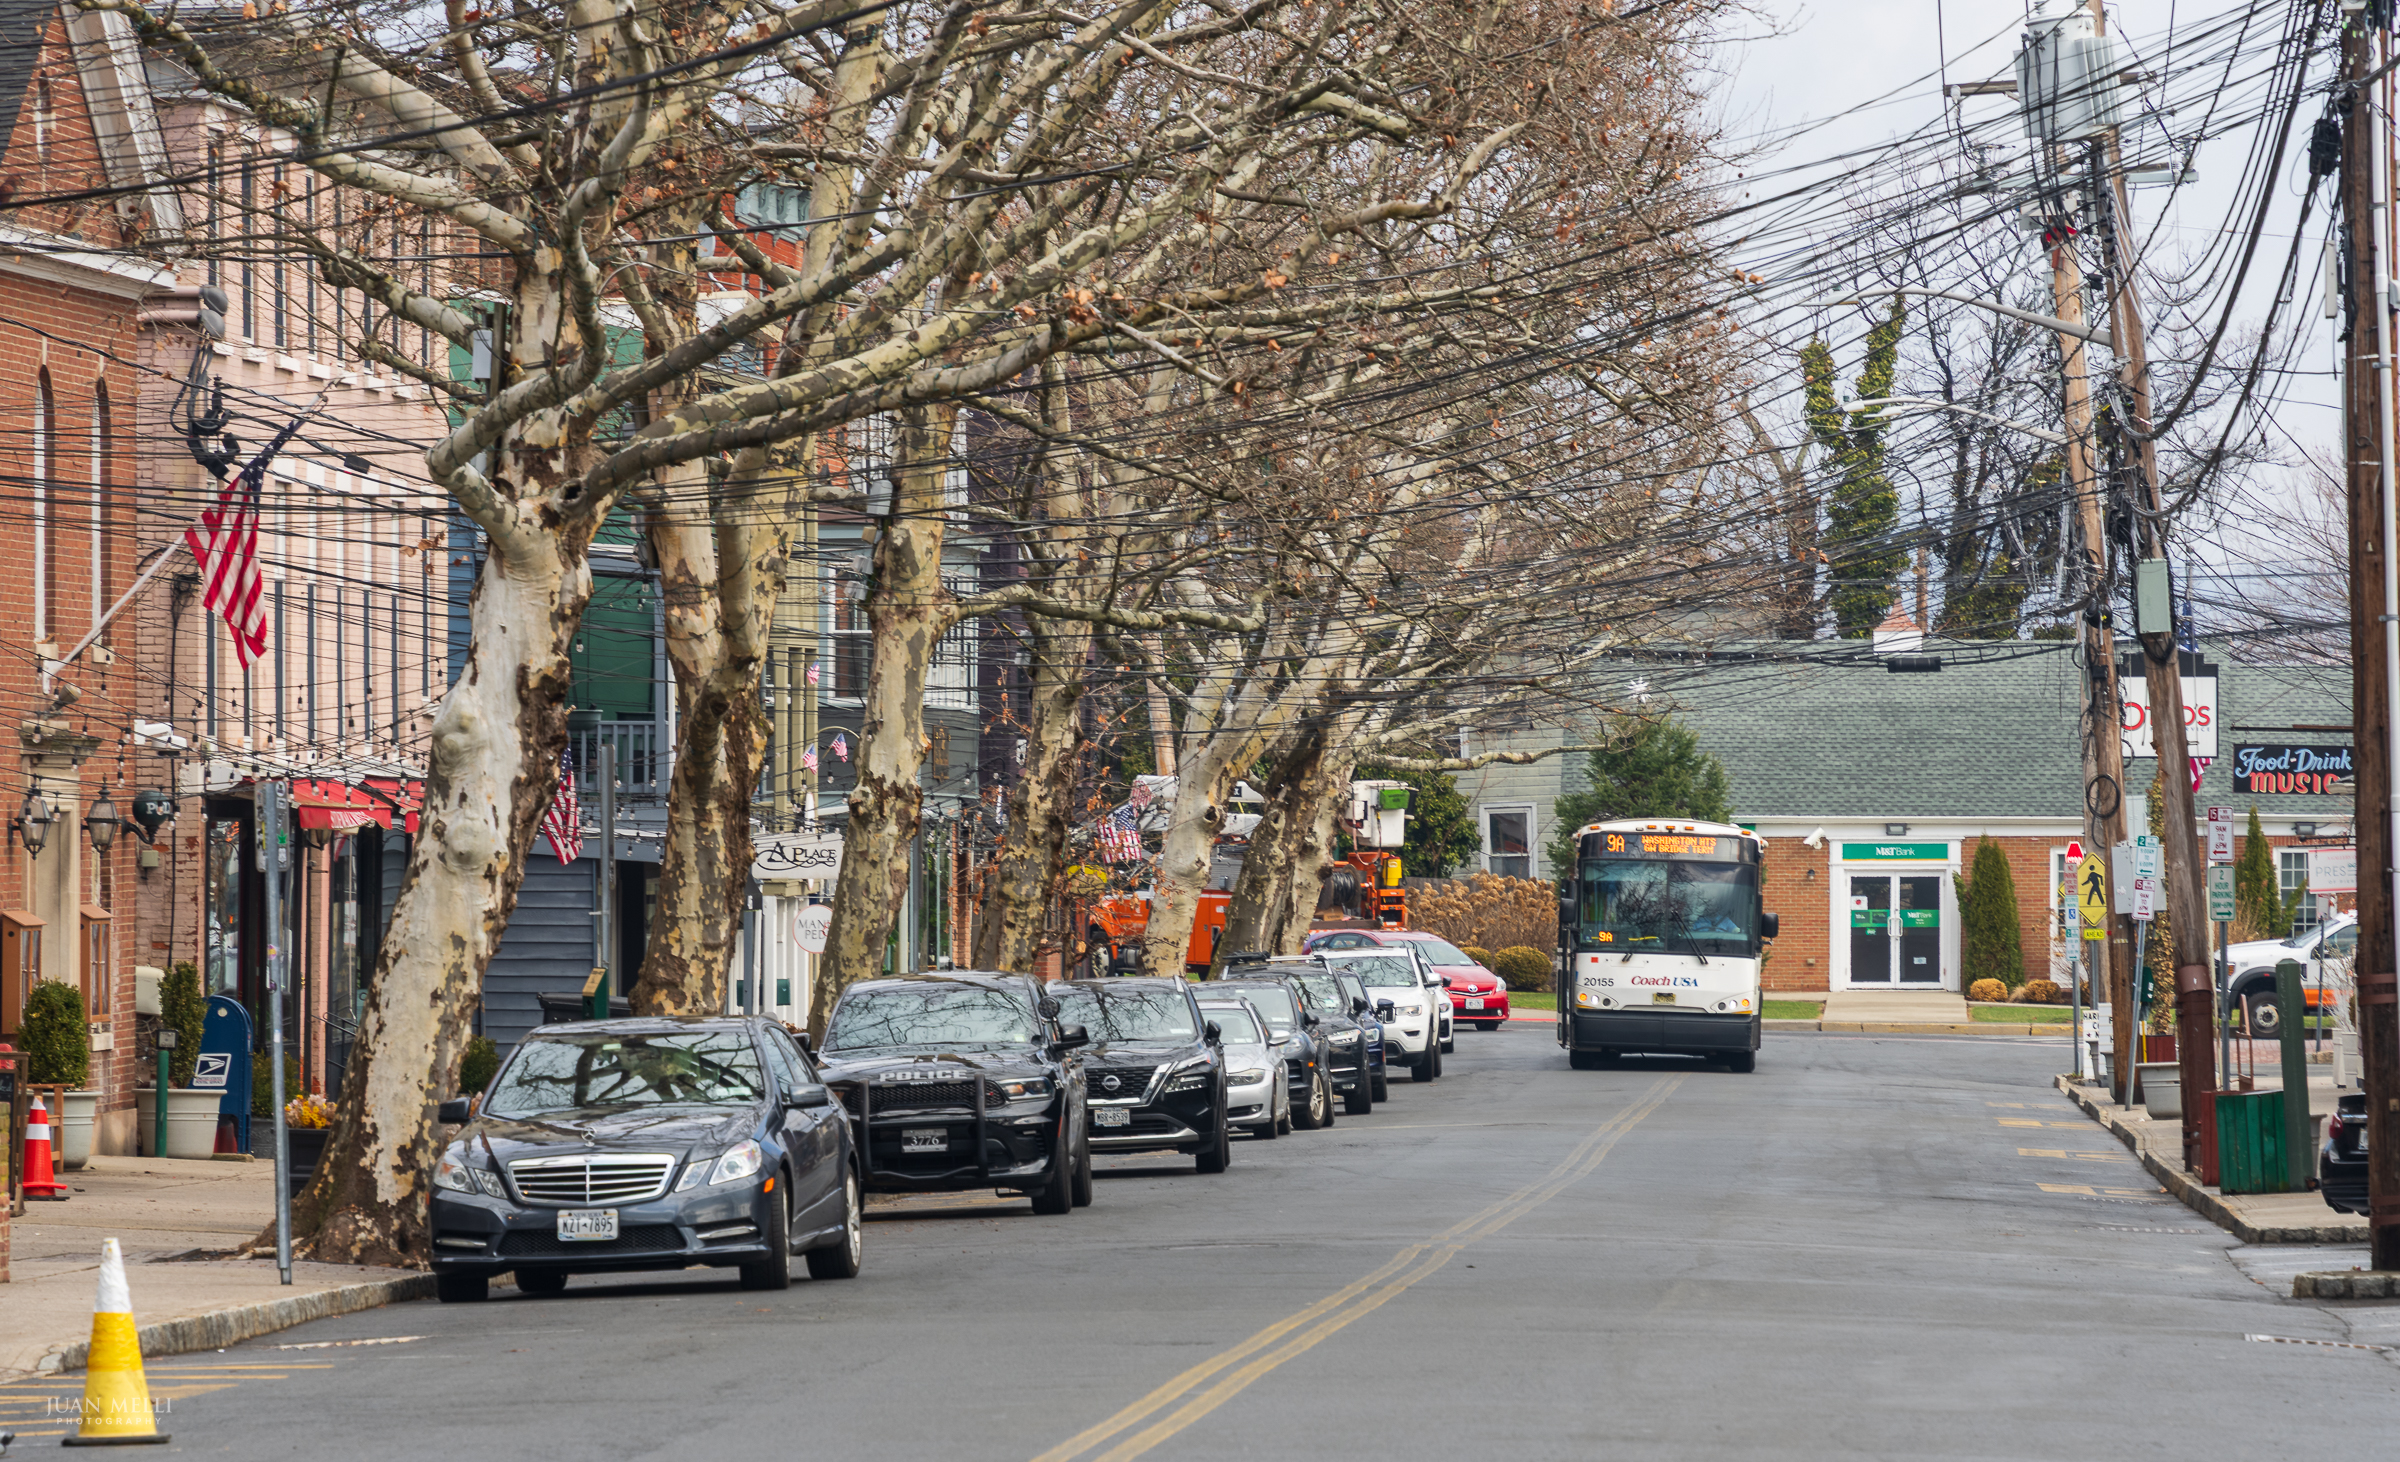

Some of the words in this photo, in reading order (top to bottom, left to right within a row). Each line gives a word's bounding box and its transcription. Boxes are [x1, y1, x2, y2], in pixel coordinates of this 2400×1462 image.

[2122, 702, 2210, 730] OO'S
[2210, 808, 2217, 820] 15
[1607, 834, 1625, 852] 9A
[1642, 835, 1698, 846] WASHINGTON
[1698, 837, 1717, 846] HTS
[2139, 837, 2145, 845] 2
[1658, 845, 1690, 853] BRIDGE
[1692, 846, 1714, 854] TERM
[1876, 847, 1895, 856] M&T
[1896, 847, 1915, 856] Bank
[2219, 870, 2224, 880] 2
[805, 930, 827, 939] PED
[1598, 931, 1613, 942] 9A
[1584, 978, 1614, 987] 20155
[1631, 975, 1671, 986] Coach
[1673, 977, 1698, 987] USA
[880, 1069, 967, 1082] POLICE
[910, 1136, 939, 1146] 3776
